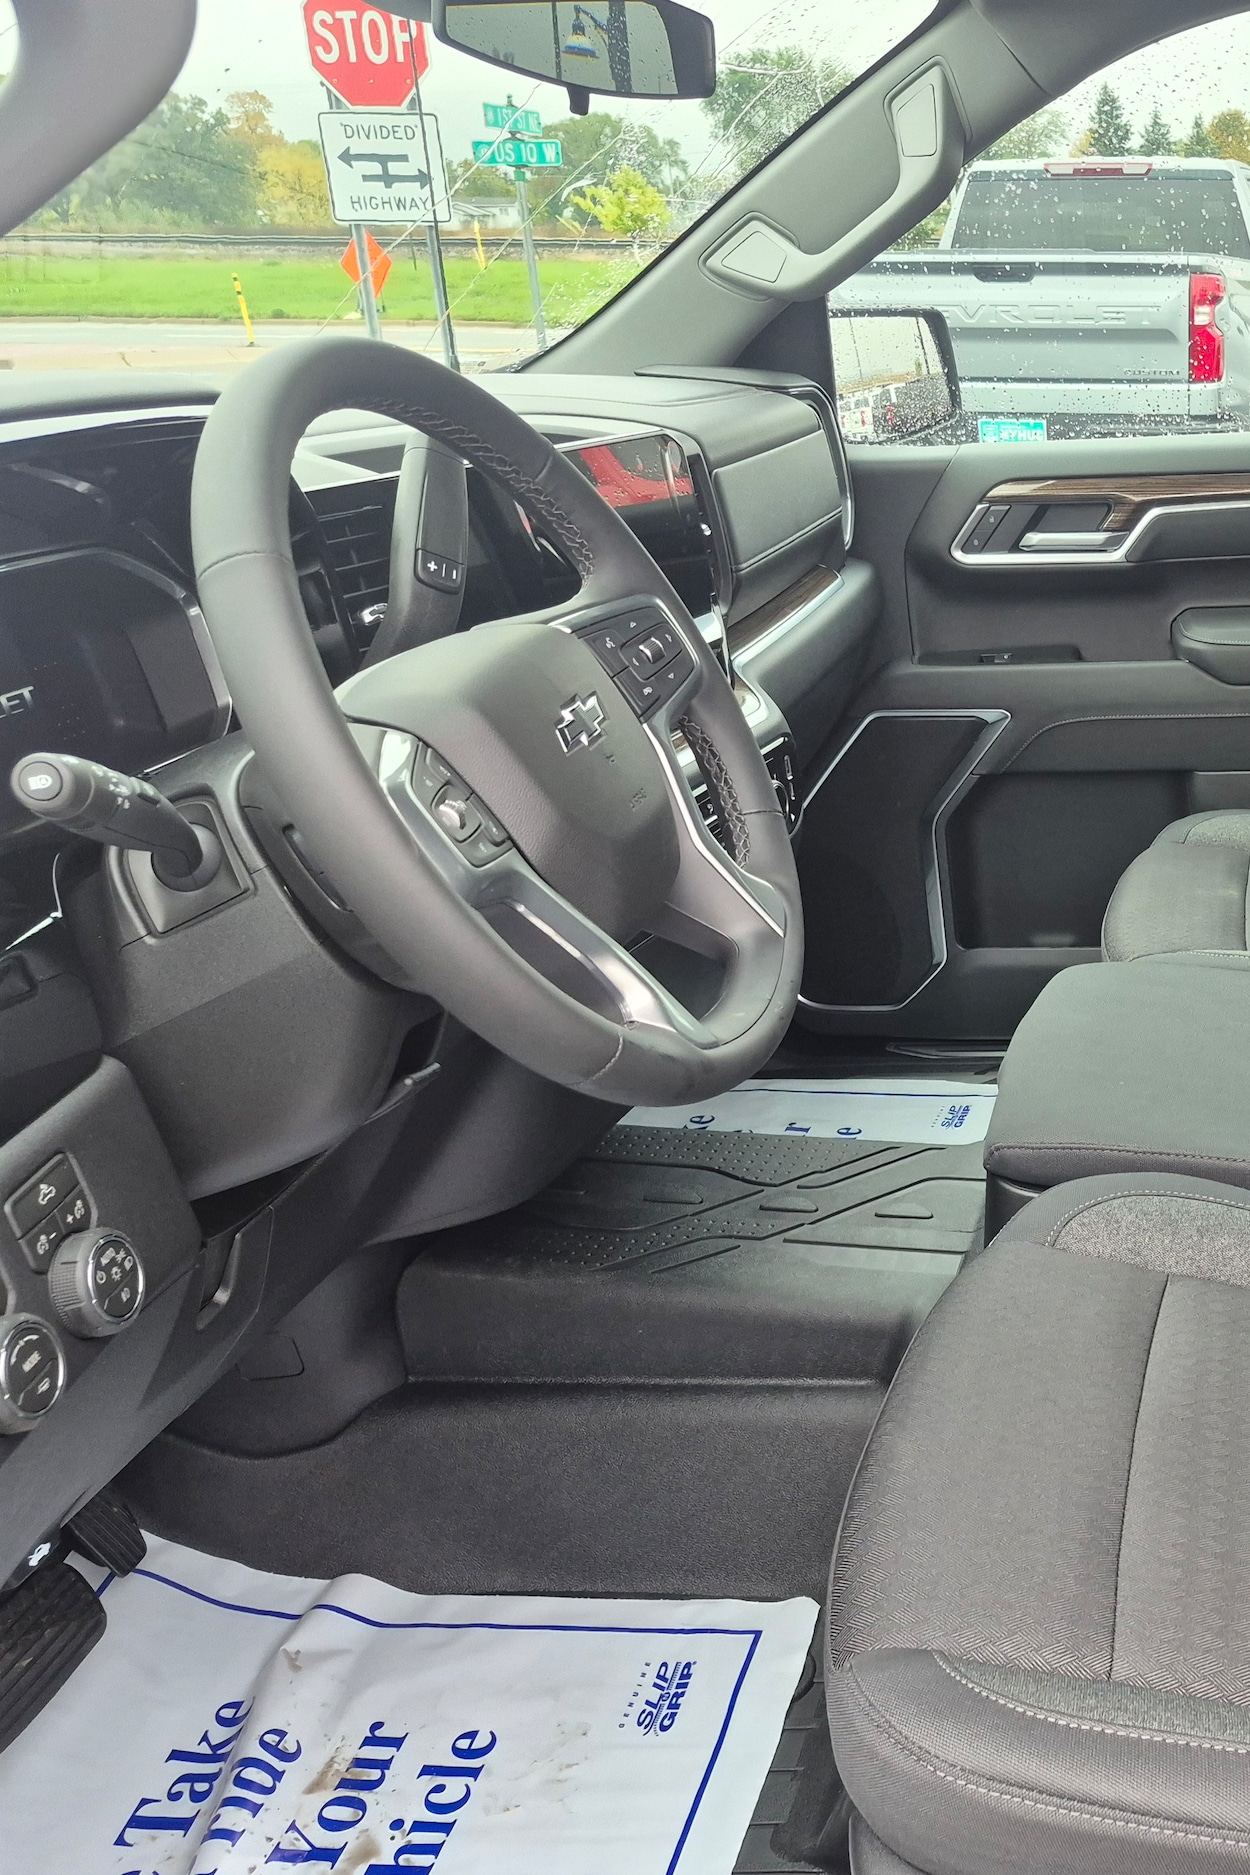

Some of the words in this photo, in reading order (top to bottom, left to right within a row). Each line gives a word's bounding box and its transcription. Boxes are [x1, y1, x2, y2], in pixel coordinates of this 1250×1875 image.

[313, 10, 417, 64] STOP
[343, 124, 416, 140] DIVIDED
[494, 142, 515, 163] US
[521, 143, 538, 163] 10
[541, 143, 557, 163] W
[350, 195, 429, 212] HIGHWAY
[1123, 368, 1180, 376] CUSTOM
[941, 1105, 957, 1127] SLIP
[618, 1661, 651, 1729] GENUINE
[636, 1661, 669, 1730] SLIP
[659, 1661, 694, 1732] GRIP
[113, 1696, 255, 1847] Take
[190, 1728, 302, 1875] ride
[264, 1721, 409, 1870] Your
